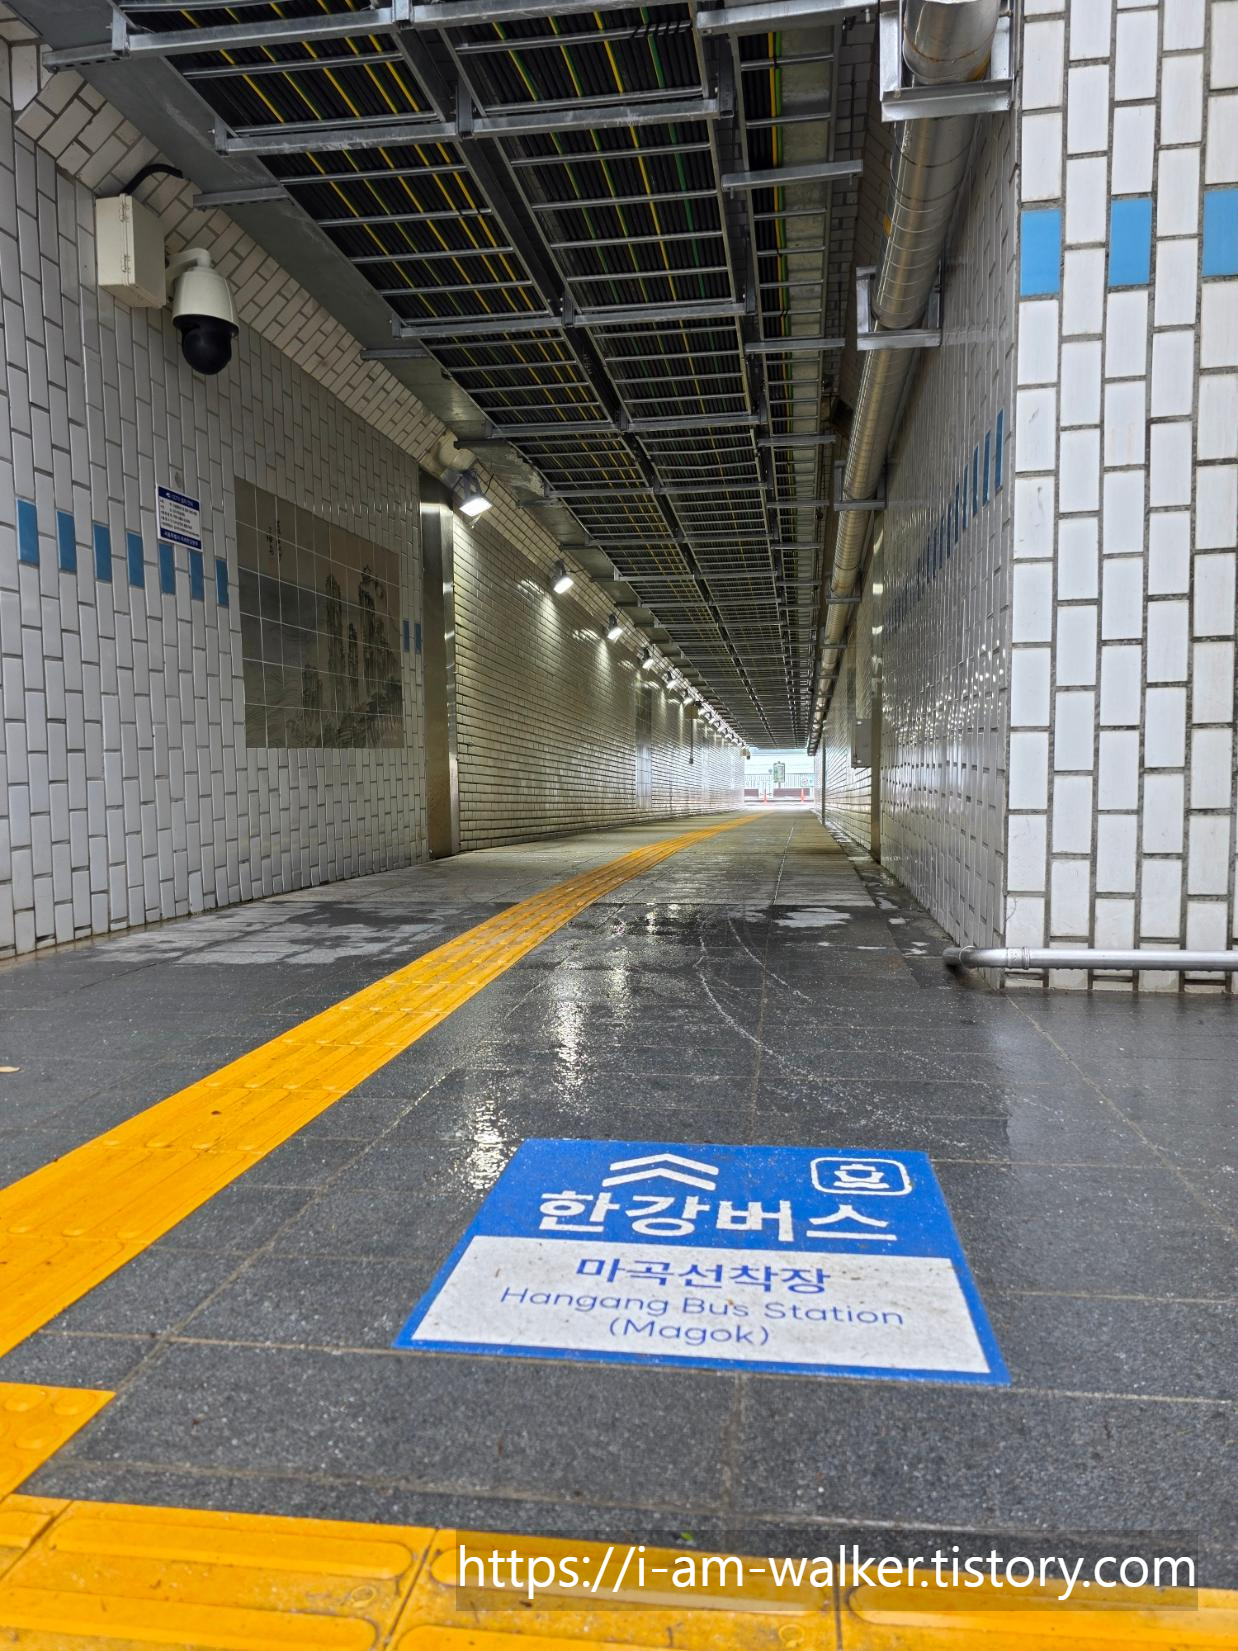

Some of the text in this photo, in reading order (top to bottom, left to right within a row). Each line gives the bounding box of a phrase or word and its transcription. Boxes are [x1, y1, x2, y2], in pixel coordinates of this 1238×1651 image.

[538, 1190, 898, 1242] 한강버스
[576, 1258, 831, 1294] 마곡선착장
[500, 1287, 904, 1326] Hangang Bus Station
[608, 1317, 770, 1346] (Magok)
